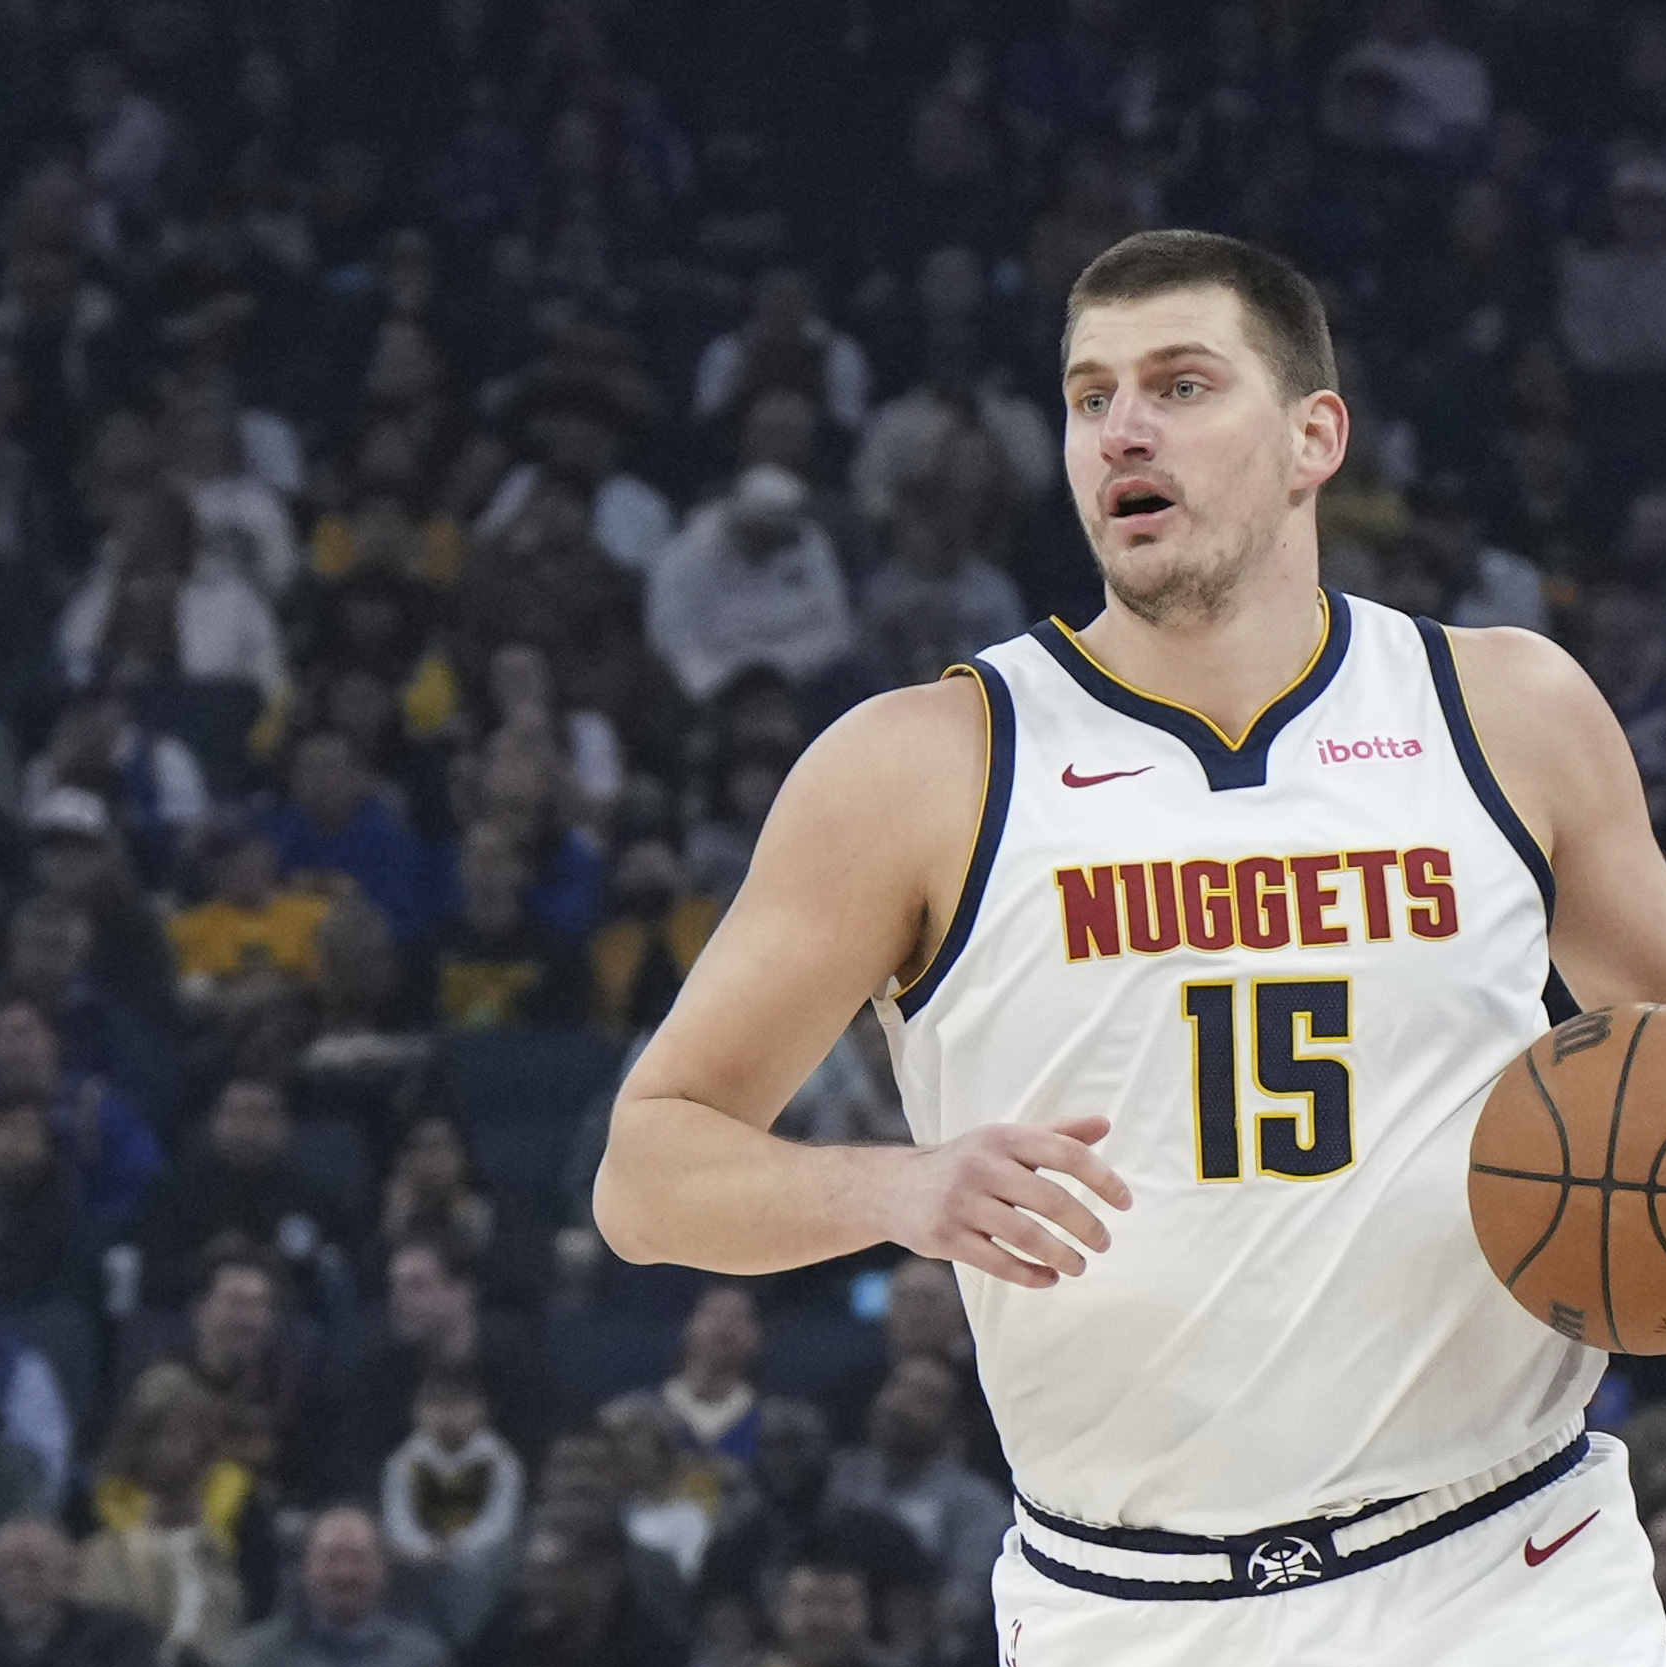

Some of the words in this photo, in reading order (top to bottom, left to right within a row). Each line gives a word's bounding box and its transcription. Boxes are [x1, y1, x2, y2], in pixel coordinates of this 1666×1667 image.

[1316, 736, 1423, 765] ibotta
[1054, 847, 1459, 962] NUGGETS
[1182, 976, 1356, 1184] 15
